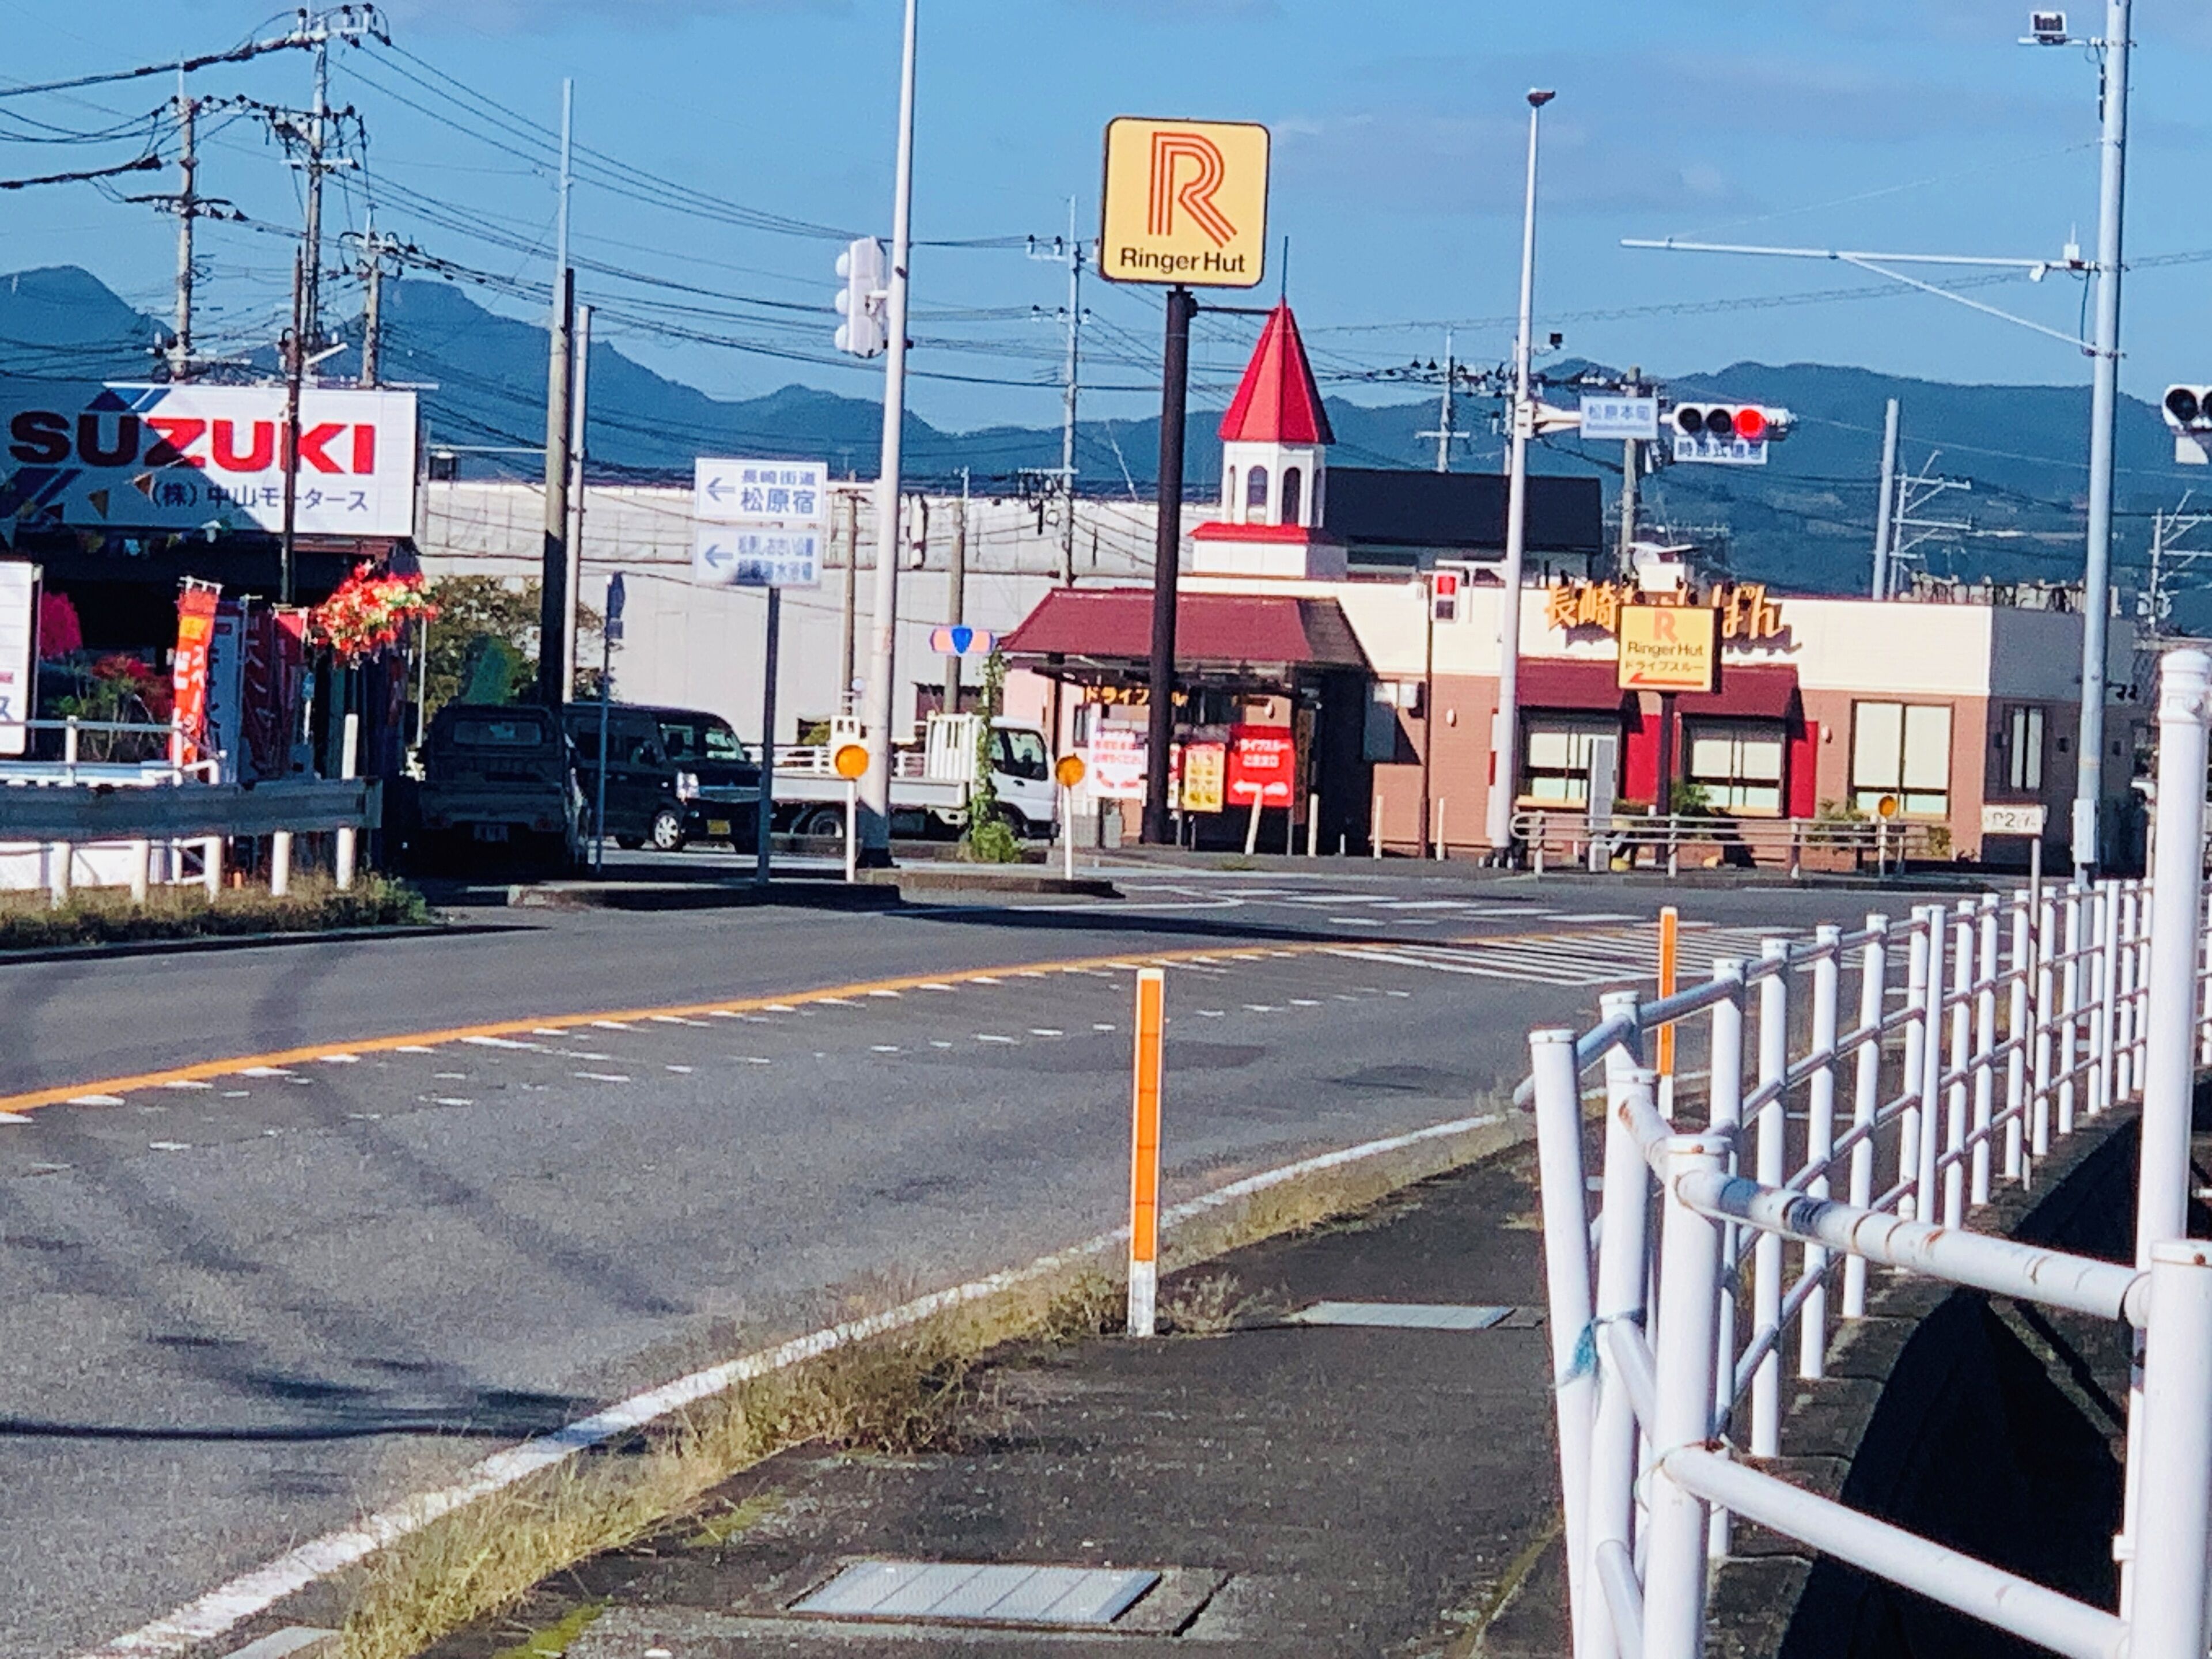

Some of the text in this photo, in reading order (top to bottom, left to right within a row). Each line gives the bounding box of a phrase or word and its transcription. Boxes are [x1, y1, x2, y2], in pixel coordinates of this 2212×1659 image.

[1148, 132, 1238, 248] R
[1120, 247, 1245, 274] Ringer Hut
[9, 410, 375, 475] SUZUKI
[741, 469, 816, 486] 長崎街道
[741, 487, 816, 514] 松原宿
[1627, 642, 1704, 657] Ringer Hut
[1624, 661, 1705, 673] ドライブスルー
